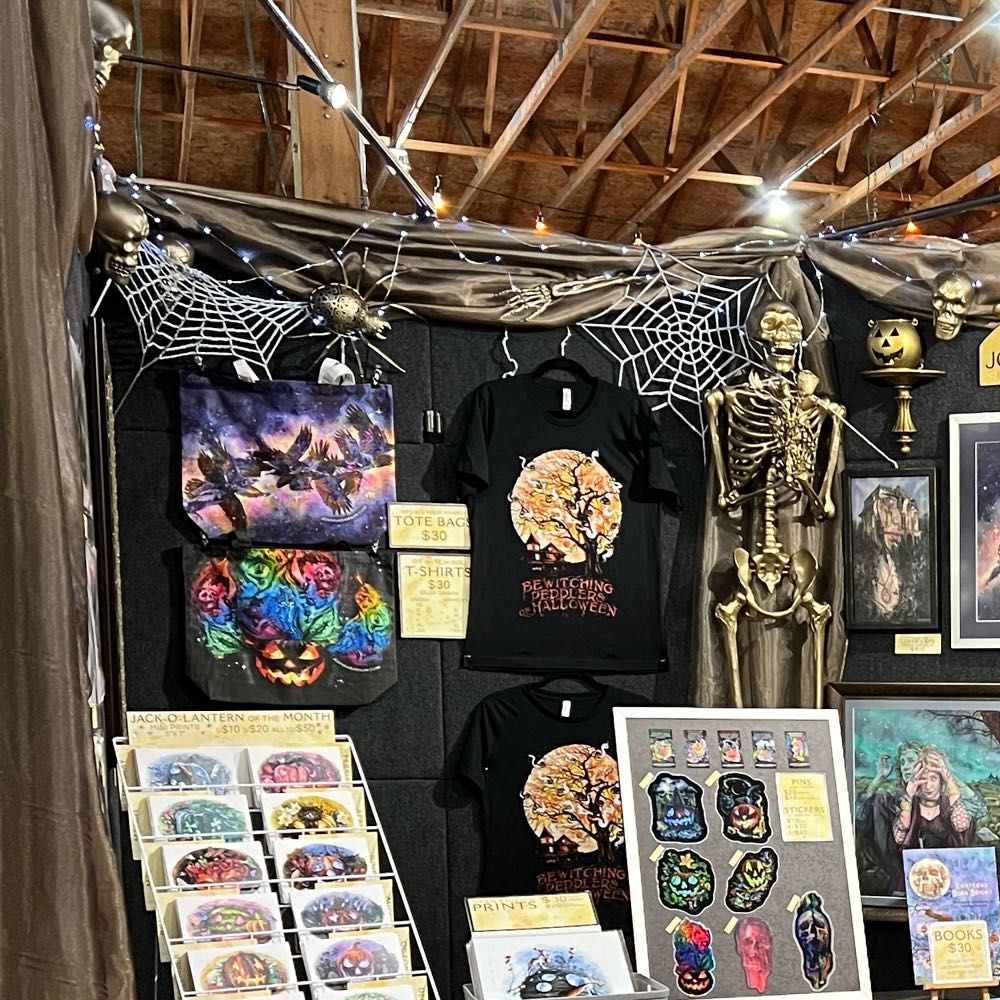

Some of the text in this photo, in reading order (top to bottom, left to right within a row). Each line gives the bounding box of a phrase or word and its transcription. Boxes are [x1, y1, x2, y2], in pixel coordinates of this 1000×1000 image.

[393, 515, 433, 527] TOTE
[421, 529, 447, 541] $30
[405, 565, 472, 577] T-SHIRTS
[427, 579, 451, 590] $30
[521, 577, 614, 595] BEWITCHING
[531, 588, 606, 602] PEDDLERS
[531, 599, 618, 617] HALLOWEEN
[130, 713, 245, 723] JACK-O-LANTERN
[283, 712, 331, 721] MONTH
[783, 806, 825, 814] STICKERS
[536, 865, 626, 885] BEWITCHING
[472, 901, 538, 912] PRINTS
[541, 895, 568, 904] $30
[934, 929, 983, 941] BOOKS
[948, 942, 972, 953] $30
